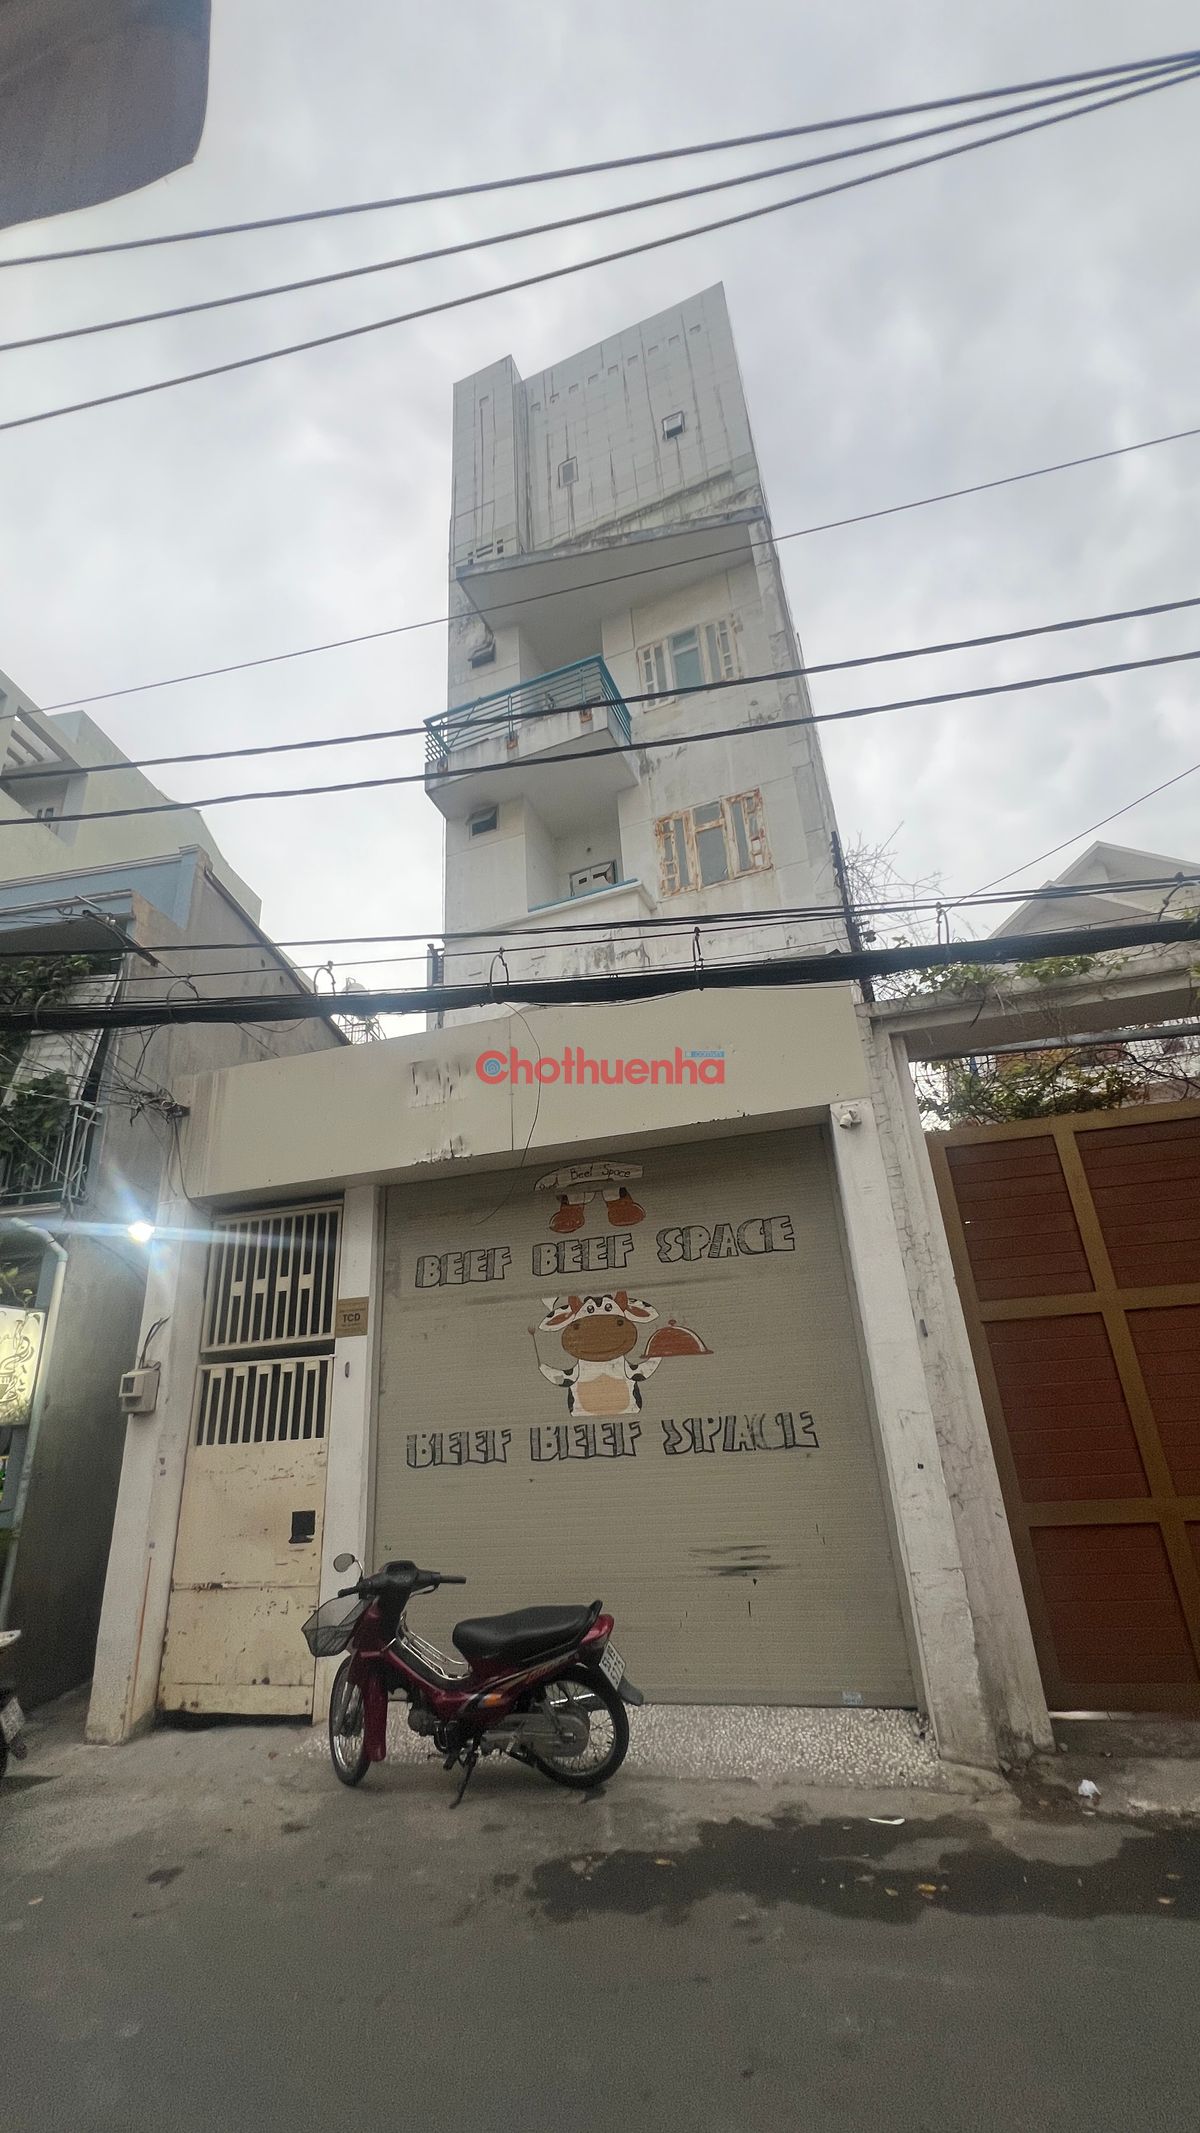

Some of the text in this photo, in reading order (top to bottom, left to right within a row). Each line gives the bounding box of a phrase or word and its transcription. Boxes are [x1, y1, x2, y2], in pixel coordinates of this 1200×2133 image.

[602, 1163, 631, 1178] Space
[415, 1215, 796, 1288] BEEF BEEF SPACE
[343, 1313, 361, 1323] TCD
[406, 1429, 512, 1469] BEEF
[530, 1421, 642, 1462] BEEF
